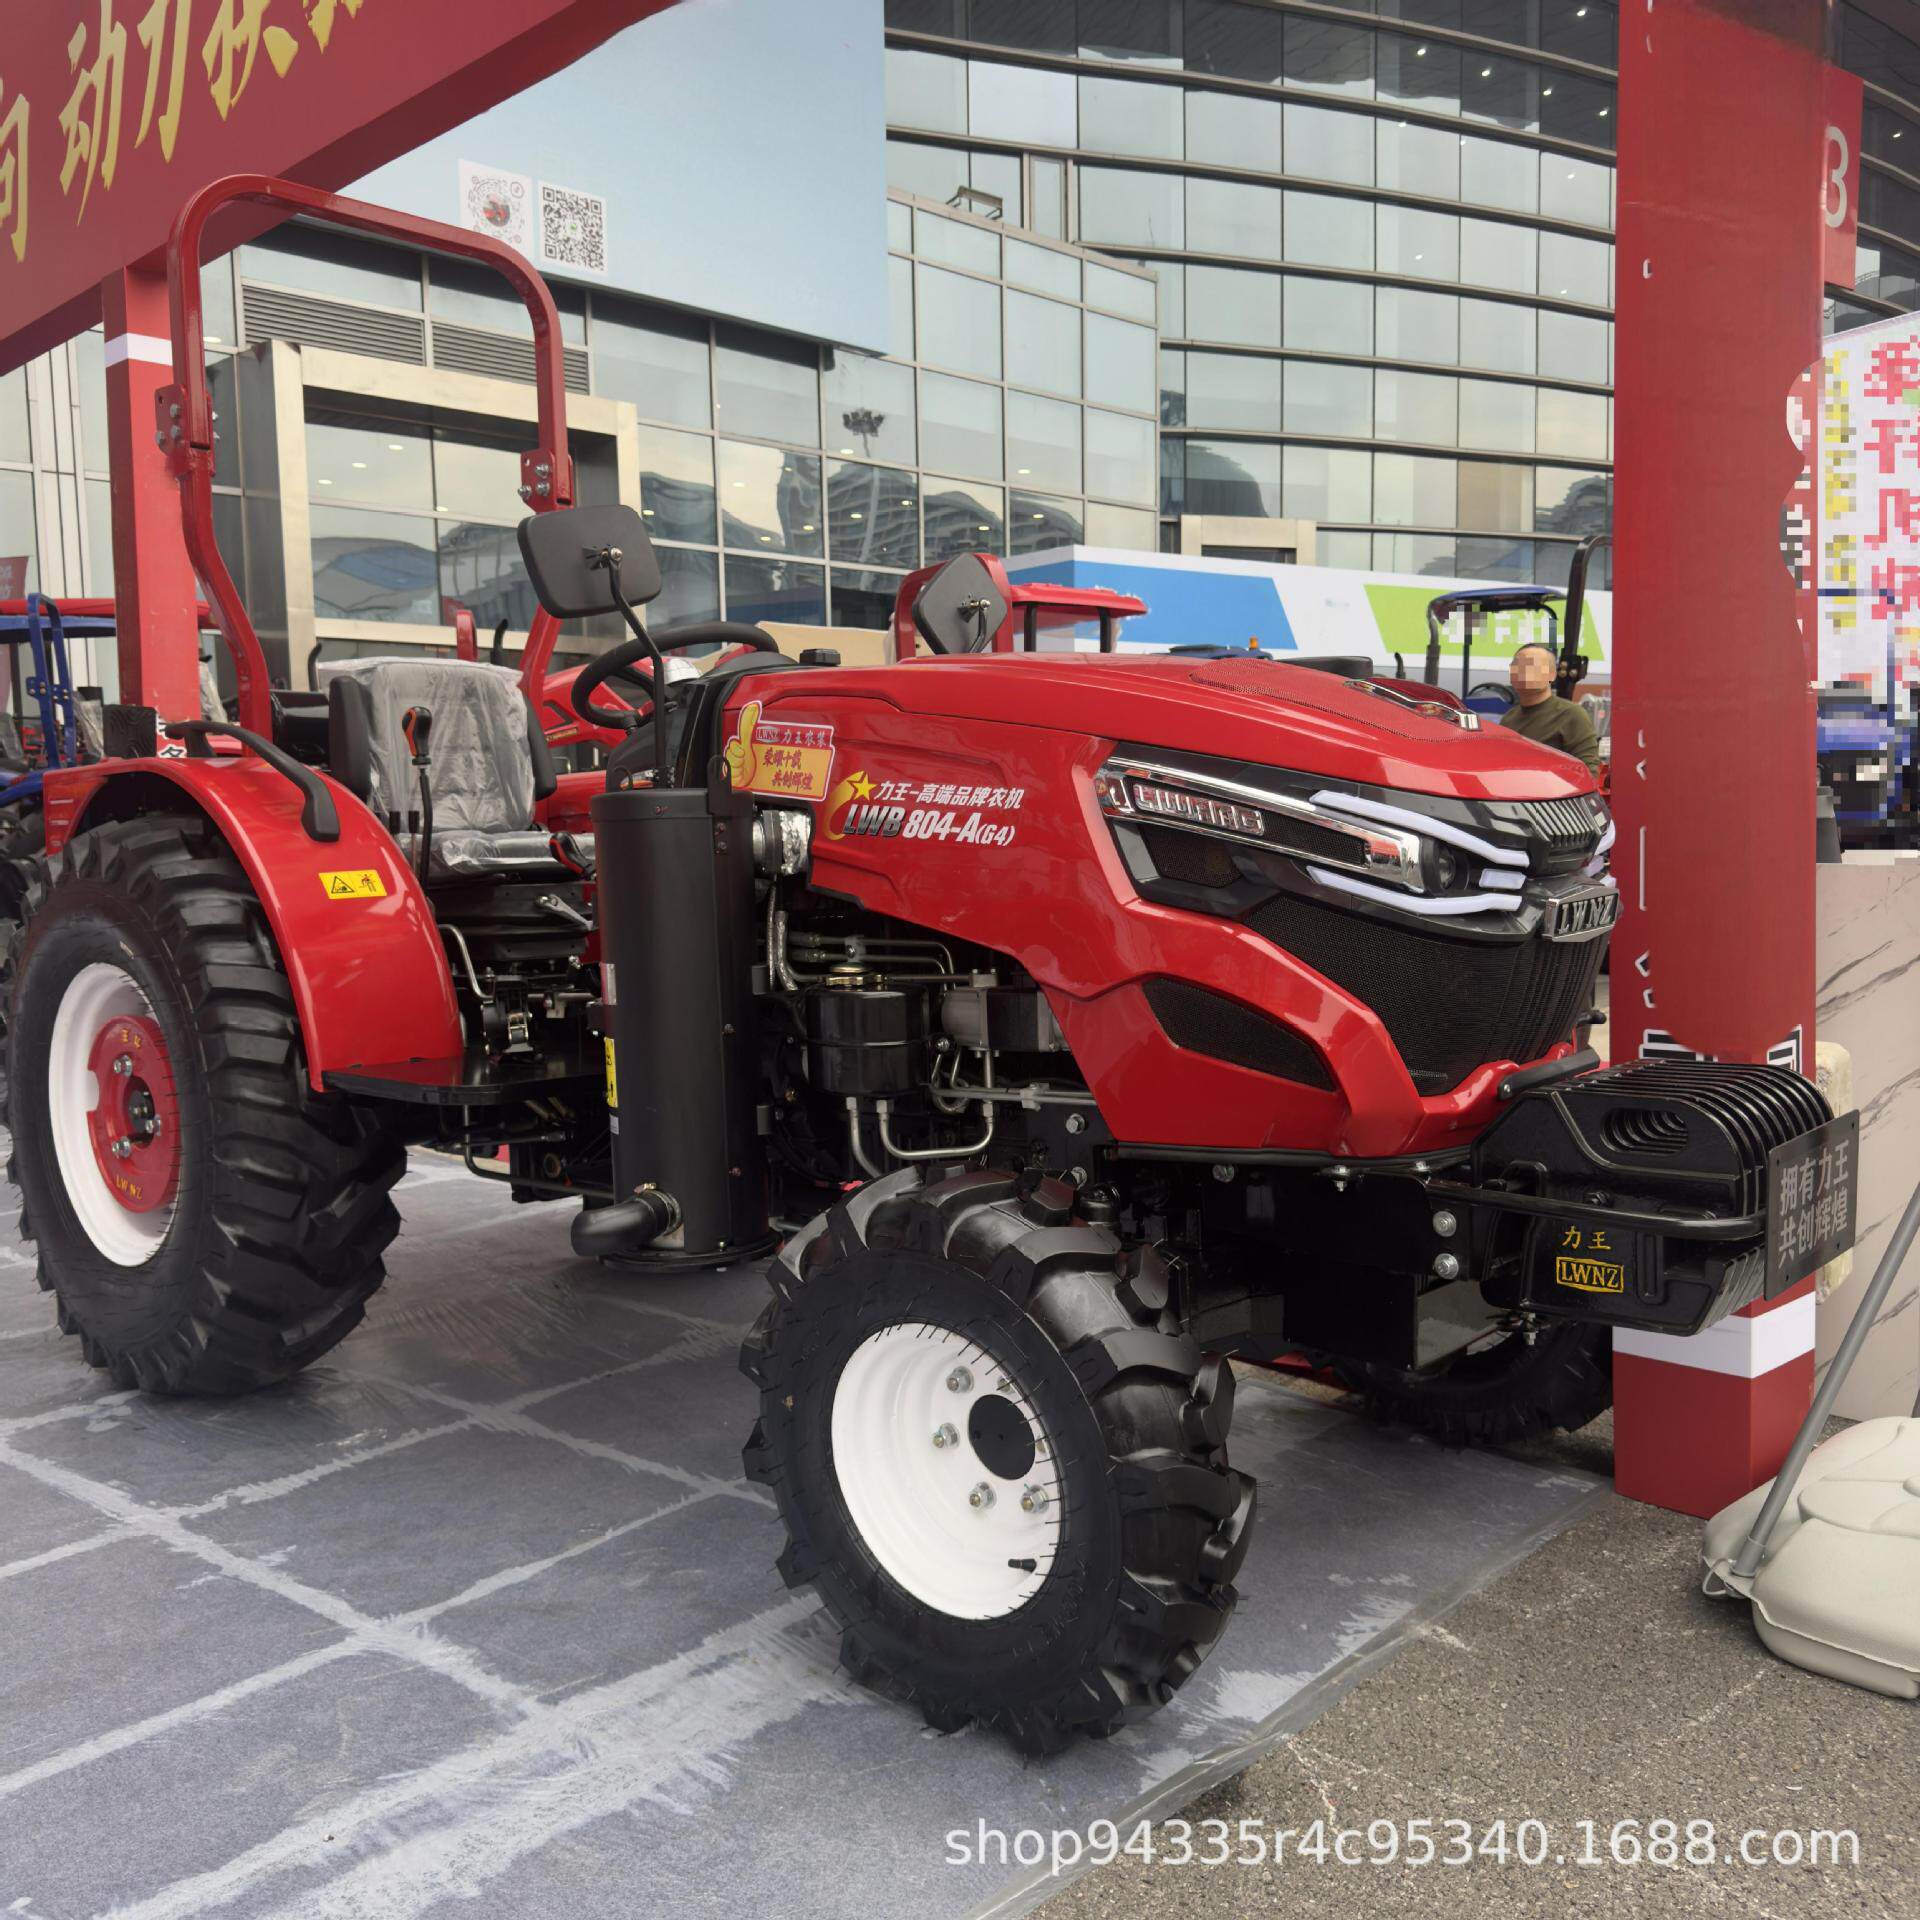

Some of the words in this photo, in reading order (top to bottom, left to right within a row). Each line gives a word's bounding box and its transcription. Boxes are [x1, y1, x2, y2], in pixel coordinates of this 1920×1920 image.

[874, 780, 1025, 809] 力王-高端品牌农机
[843, 804, 906, 837] LWB
[1778, 1140, 1849, 1217] 拥有力王
[1561, 1225, 1612, 1250] 力王
[1778, 1187, 1848, 1269] 共创辉煌
[1561, 1261, 1619, 1288] LWNZ
